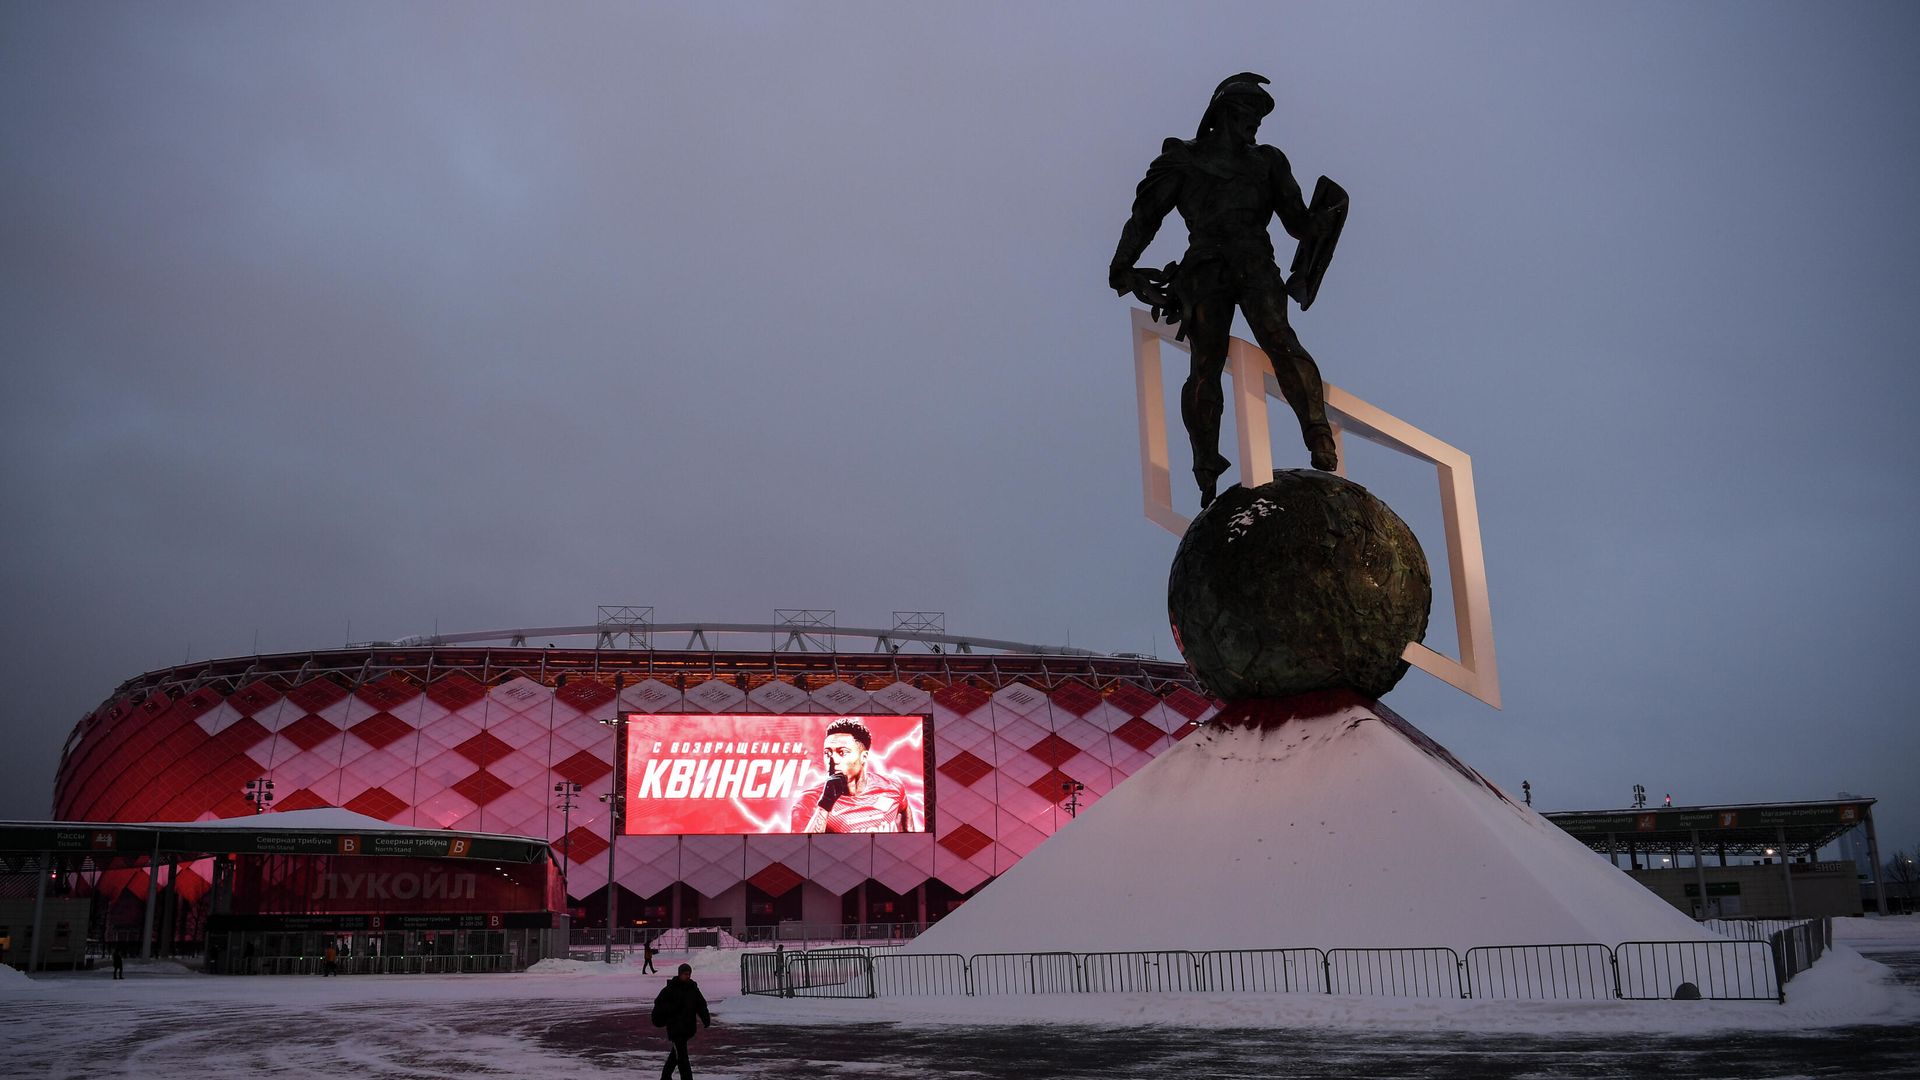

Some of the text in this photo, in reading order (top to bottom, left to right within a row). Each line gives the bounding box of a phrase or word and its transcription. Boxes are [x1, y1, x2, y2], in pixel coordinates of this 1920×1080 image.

[652, 741, 809, 756] С ВОЗВРАЩЕНИЕМ,
[637, 758, 812, 799] КВИНСИ!
[256, 836, 332, 845] Северная трибуна
[375, 838, 448, 847] Северная трибуна
[1815, 863, 1842, 873] SHOP
[311, 865, 477, 899] ЛУКОЙЛ
